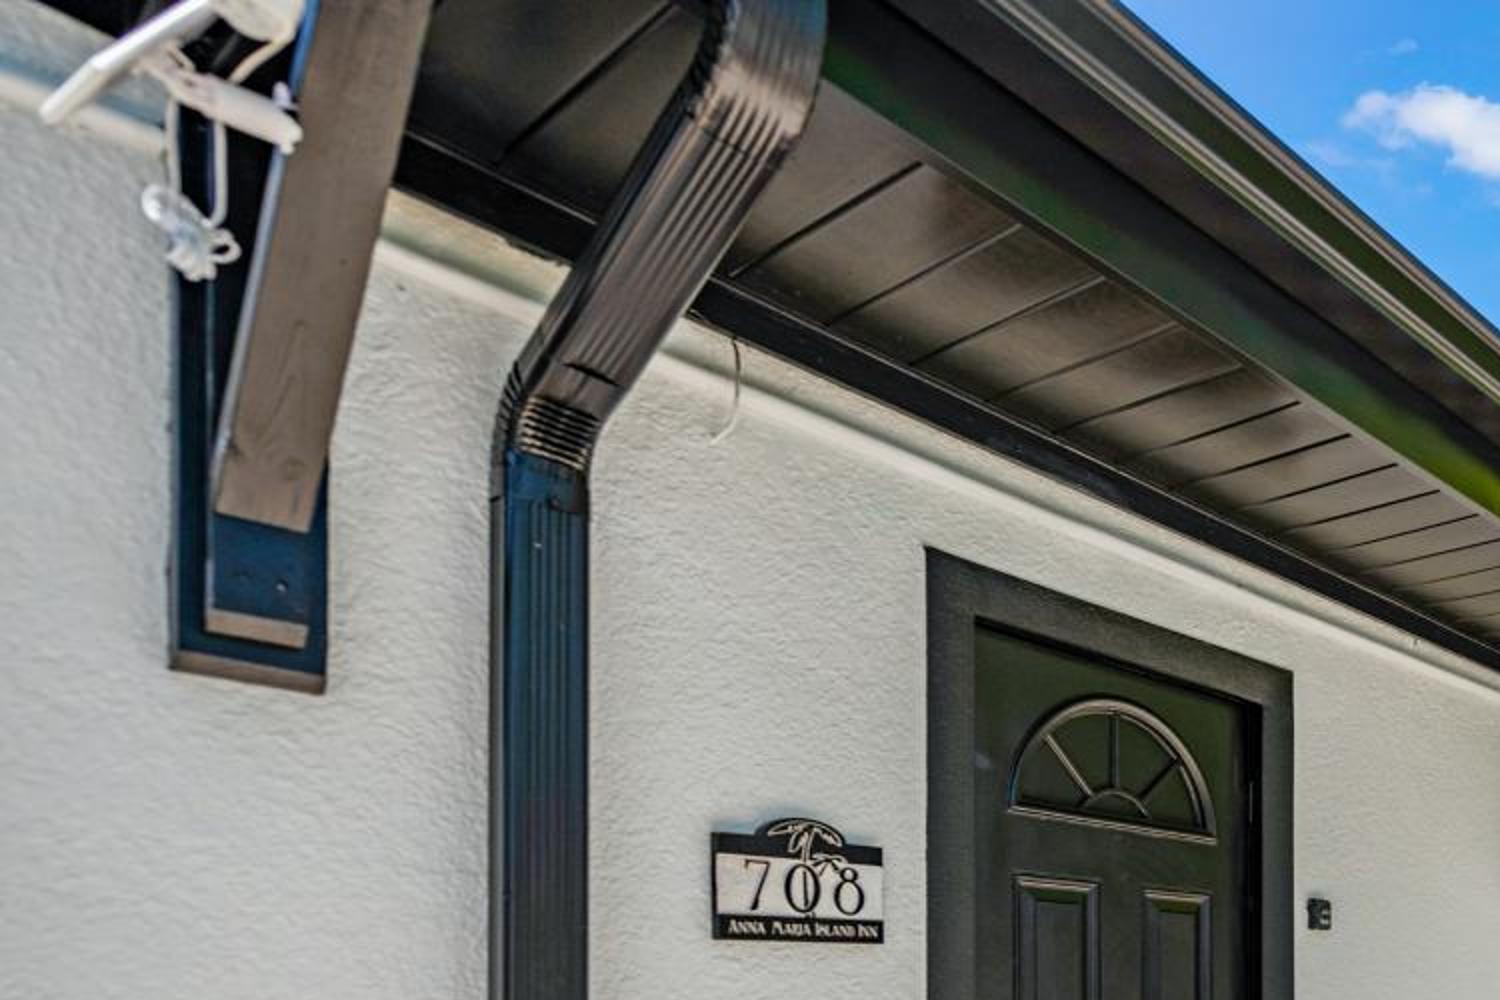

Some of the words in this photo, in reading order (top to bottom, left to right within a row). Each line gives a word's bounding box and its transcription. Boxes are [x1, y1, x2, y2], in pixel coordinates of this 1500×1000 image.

[744, 858, 865, 916] 708
[728, 919, 767, 935] ANNA
[771, 921, 811, 937] MARIA
[815, 923, 856, 938] ISLAND
[858, 924, 879, 939] INN
